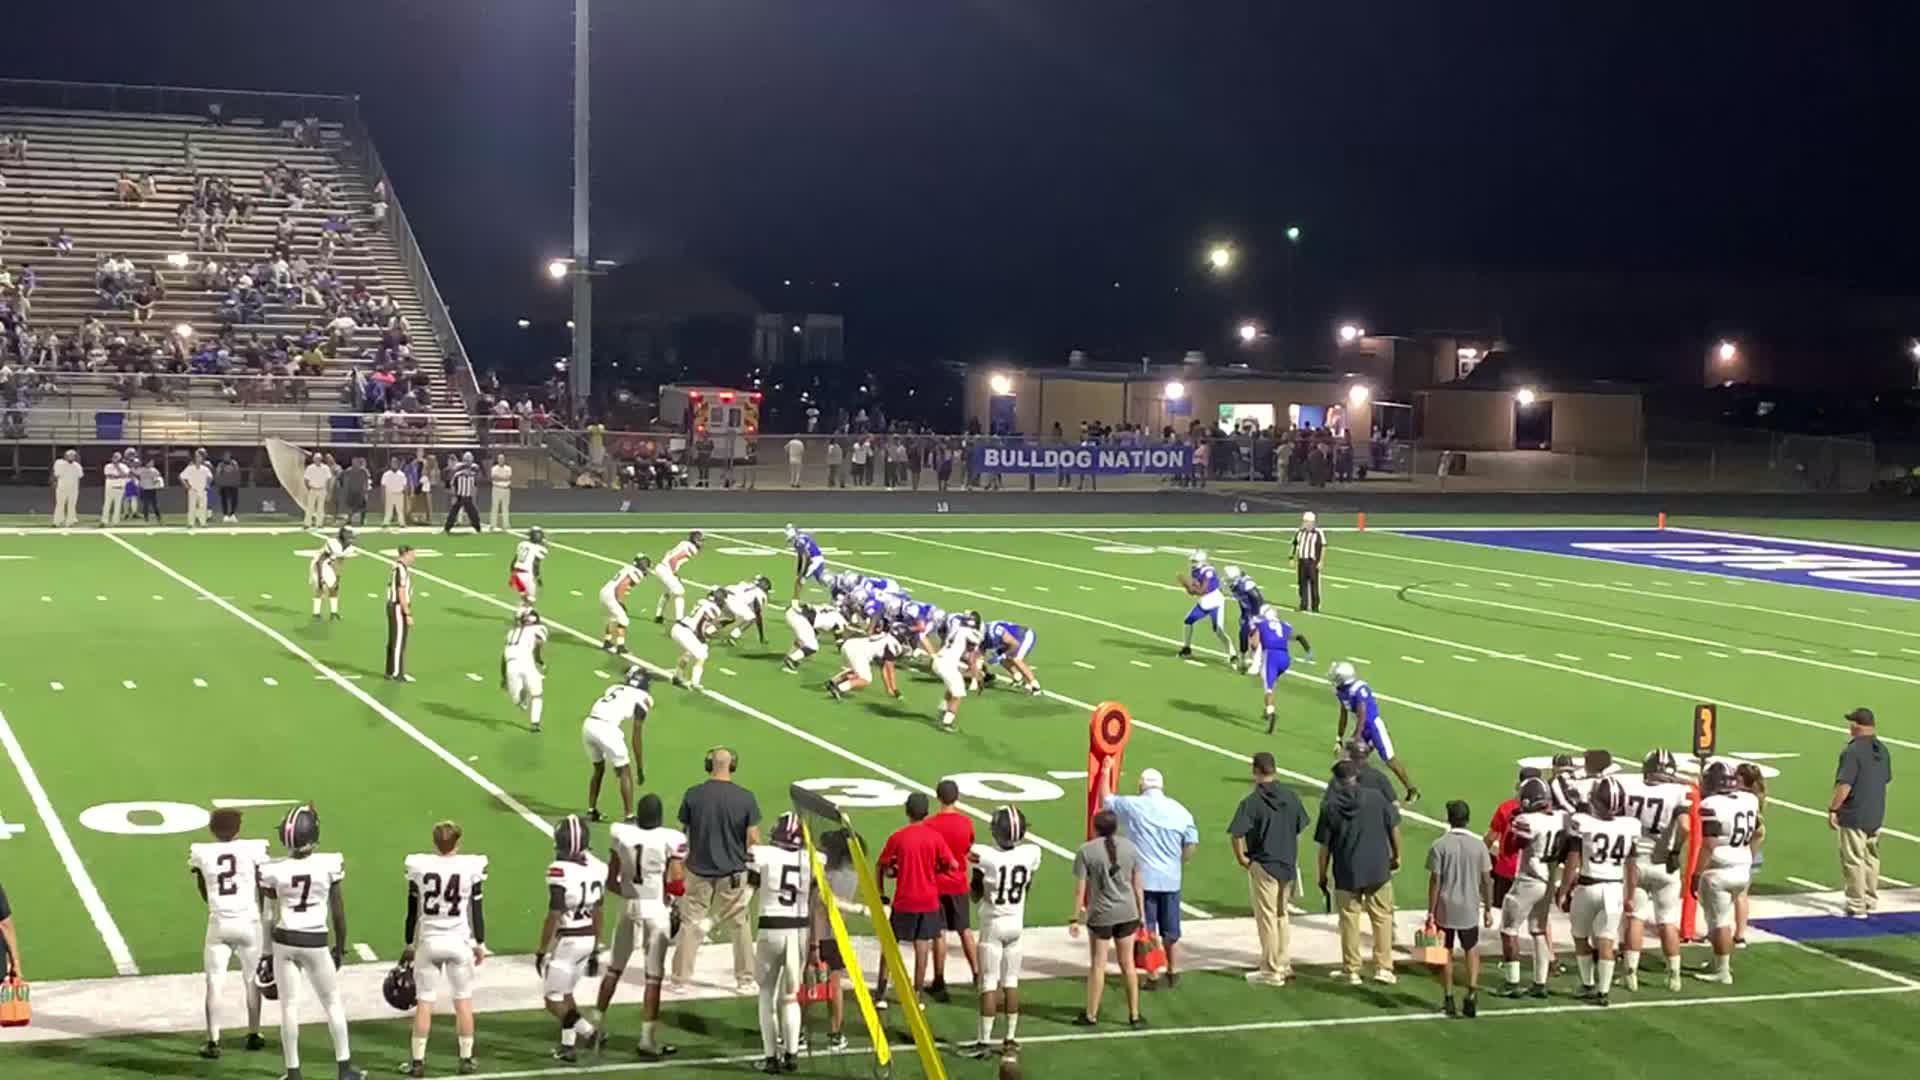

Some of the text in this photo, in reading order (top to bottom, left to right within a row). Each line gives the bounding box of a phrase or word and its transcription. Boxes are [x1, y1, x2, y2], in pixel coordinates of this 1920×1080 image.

[984, 449, 1185, 468] BULLDOG NATION
[1699, 706, 1712, 750] 3
[792, 772, 1065, 807] 30
[1628, 794, 1664, 835] 77
[632, 843, 644, 885] 1
[1589, 832, 1626, 867] 34
[216, 853, 238, 897] 2
[290, 873, 313, 913] 7
[422, 871, 460, 917] 24
[777, 864, 800, 907] 5
[992, 864, 1026, 905] 18
